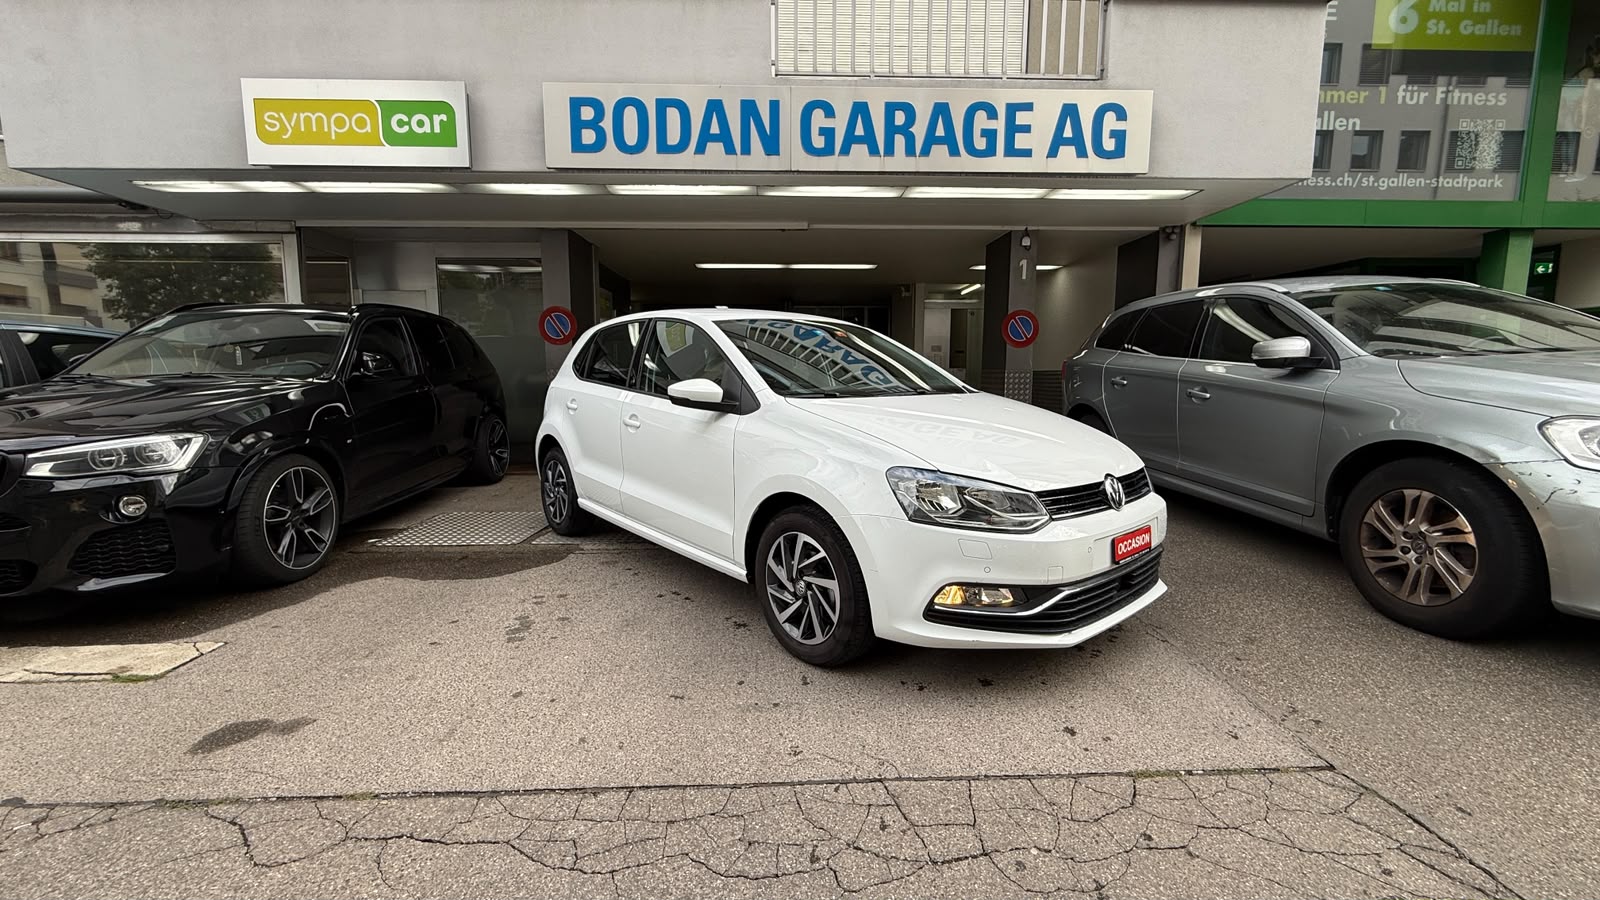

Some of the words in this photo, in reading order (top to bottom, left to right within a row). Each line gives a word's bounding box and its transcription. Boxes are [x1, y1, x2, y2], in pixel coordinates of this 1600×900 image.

[1388, 0, 1419, 34] 6
[1428, 0, 1465, 12] Mal
[1473, 0, 1491, 12] in
[1426, 19, 1451, 35] St.
[1460, 19, 1521, 36] Gallen
[1379, 86, 1387, 105] 1
[1397, 84, 1429, 105] für
[1435, 86, 1507, 106] Fitness
[264, 111, 371, 140] sympa
[390, 113, 447, 134] car
[569, 96, 781, 156] BODAN
[800, 99, 1034, 159] GARAGE
[1046, 102, 1128, 160] AG
[1019, 259, 1027, 280] 1
[1117, 532, 1150, 555] OCCASION
